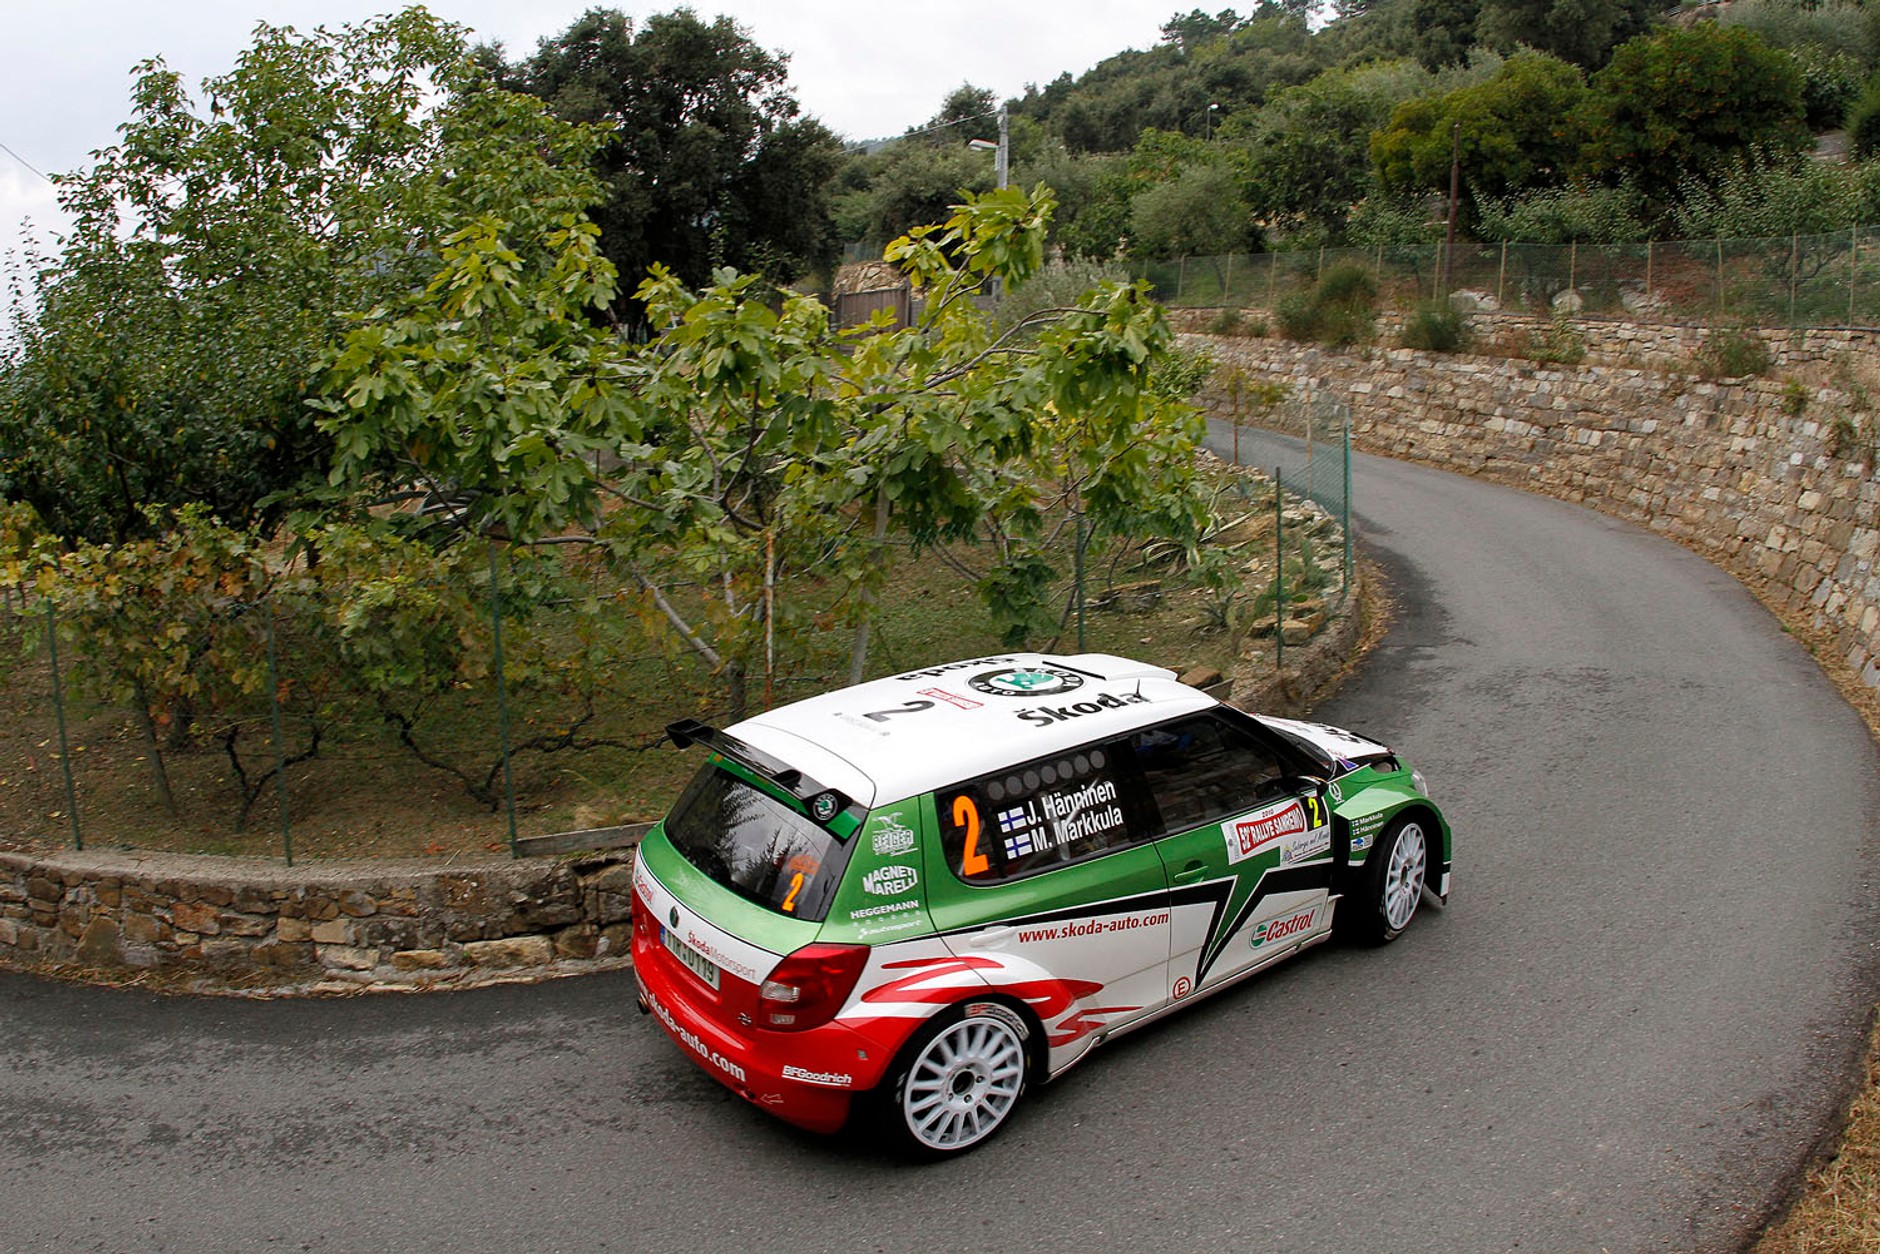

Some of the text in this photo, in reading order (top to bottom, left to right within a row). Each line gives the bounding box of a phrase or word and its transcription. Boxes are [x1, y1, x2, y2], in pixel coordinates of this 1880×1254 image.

[862, 700, 935, 722] 2
[1026, 801, 1042, 826] J.
[1031, 804, 1124, 852] M. Markkula
[1308, 797, 1322, 828] 2
[952, 795, 990, 876] 2
[782, 872, 804, 911] 2
[850, 900, 919, 919] HEGGEMANN
[1266, 908, 1316, 942] Castrol
[1018, 911, 1170, 943] www.skoda-auto.com
[782, 1065, 852, 1084] BFGoodrich
